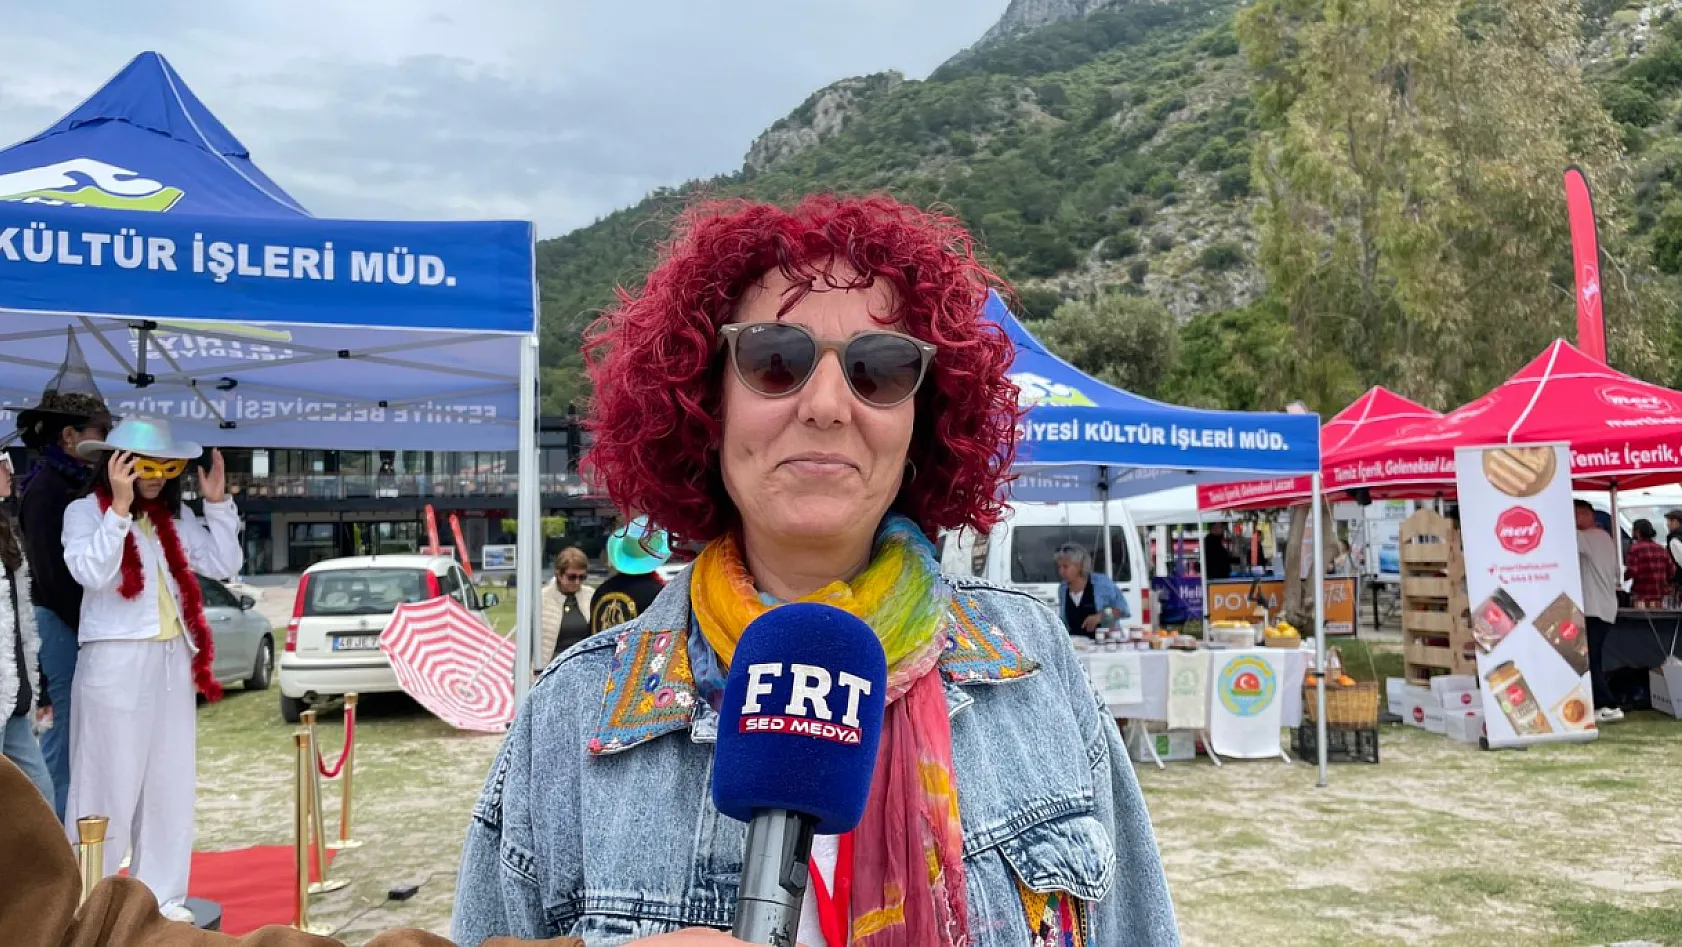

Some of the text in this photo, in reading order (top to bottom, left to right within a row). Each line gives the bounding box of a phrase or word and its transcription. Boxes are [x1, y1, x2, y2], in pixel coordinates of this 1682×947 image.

[0, 221, 457, 287] KÜLTÜR İŞLERİ MÜD.
[1085, 420, 1165, 445] KÜLTÜR
[1171, 424, 1233, 450] İŞLERİ
[1239, 427, 1290, 451] MÜD.
[1570, 447, 1621, 468] Temiz
[741, 662, 872, 729] FRT
[745, 717, 860, 743] SED MEDYA
